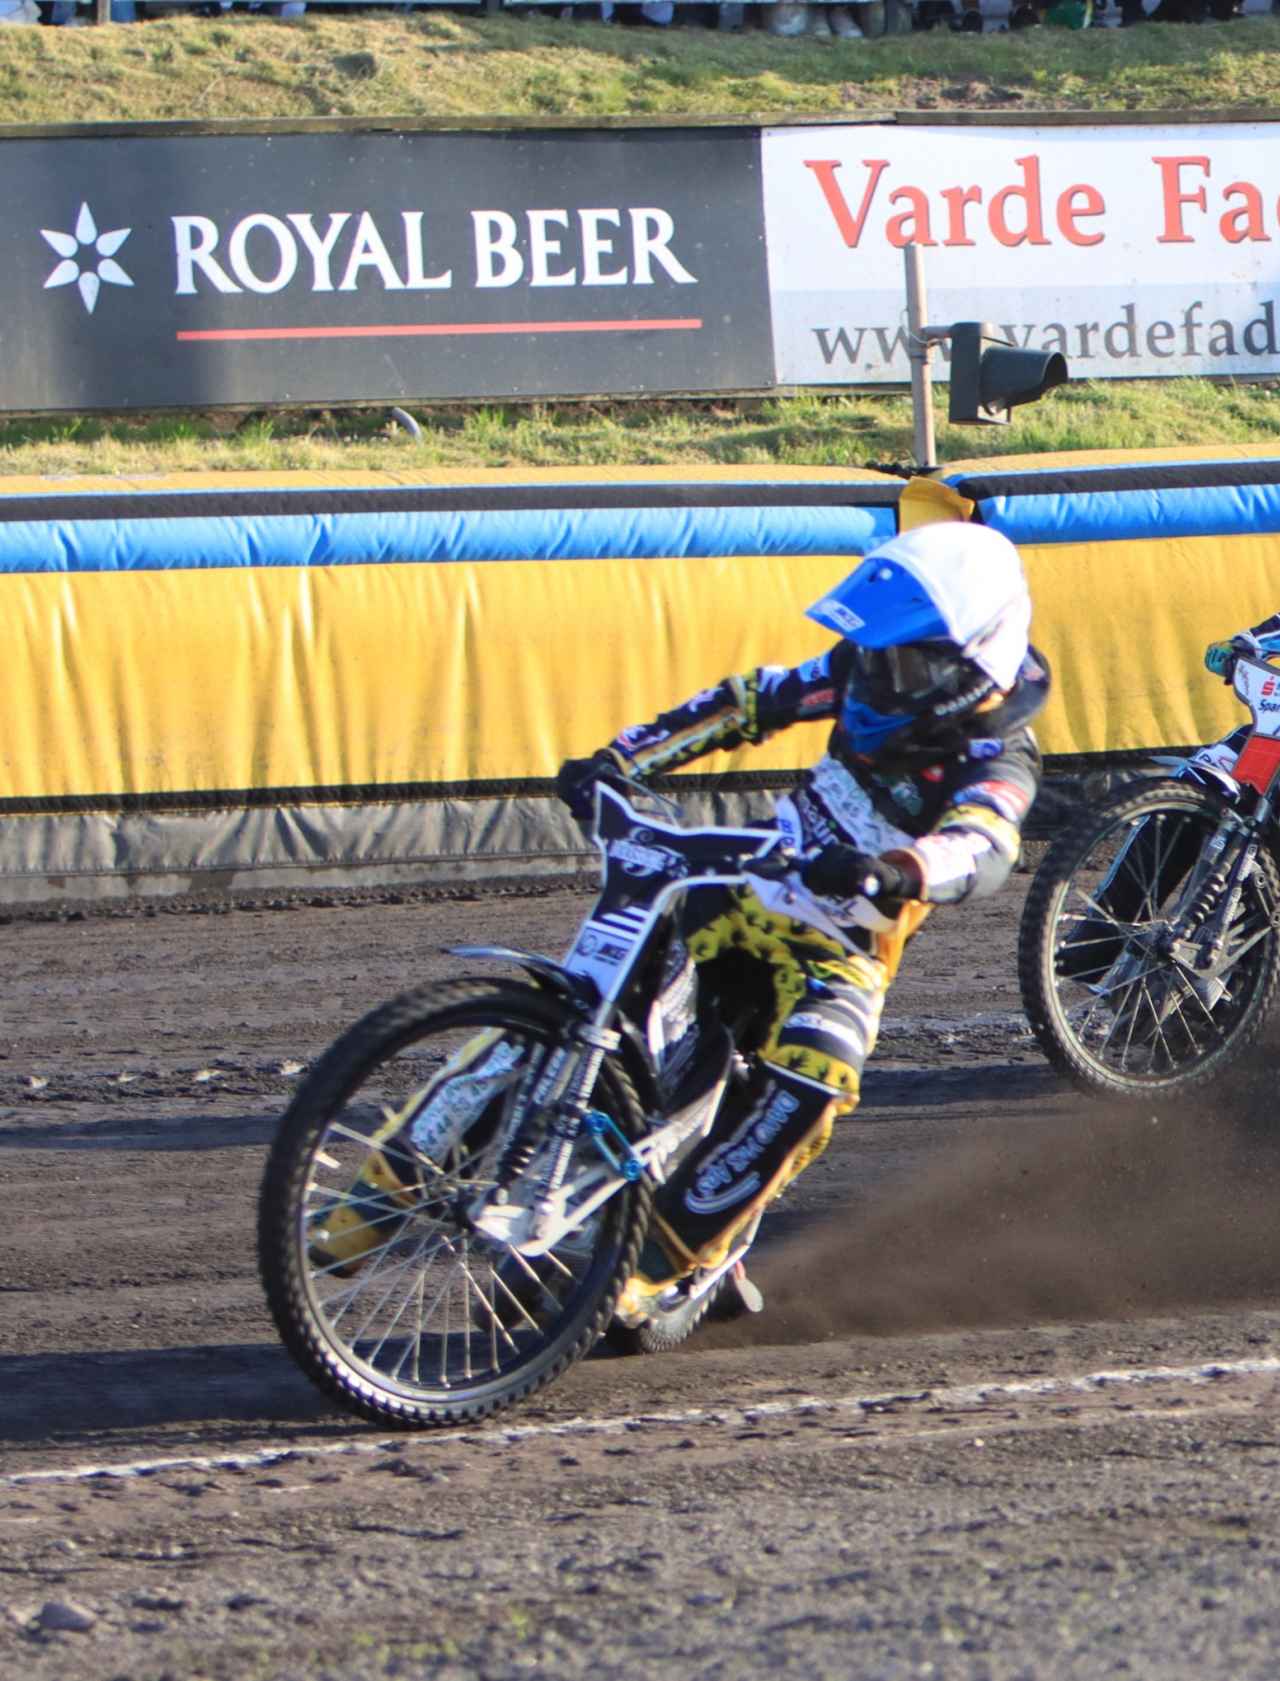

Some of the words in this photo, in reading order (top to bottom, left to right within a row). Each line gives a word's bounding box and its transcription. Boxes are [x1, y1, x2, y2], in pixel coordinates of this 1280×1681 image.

[804, 154, 1107, 249] Varde
[171, 211, 452, 295] ROYAL
[470, 207, 698, 288] BEER
